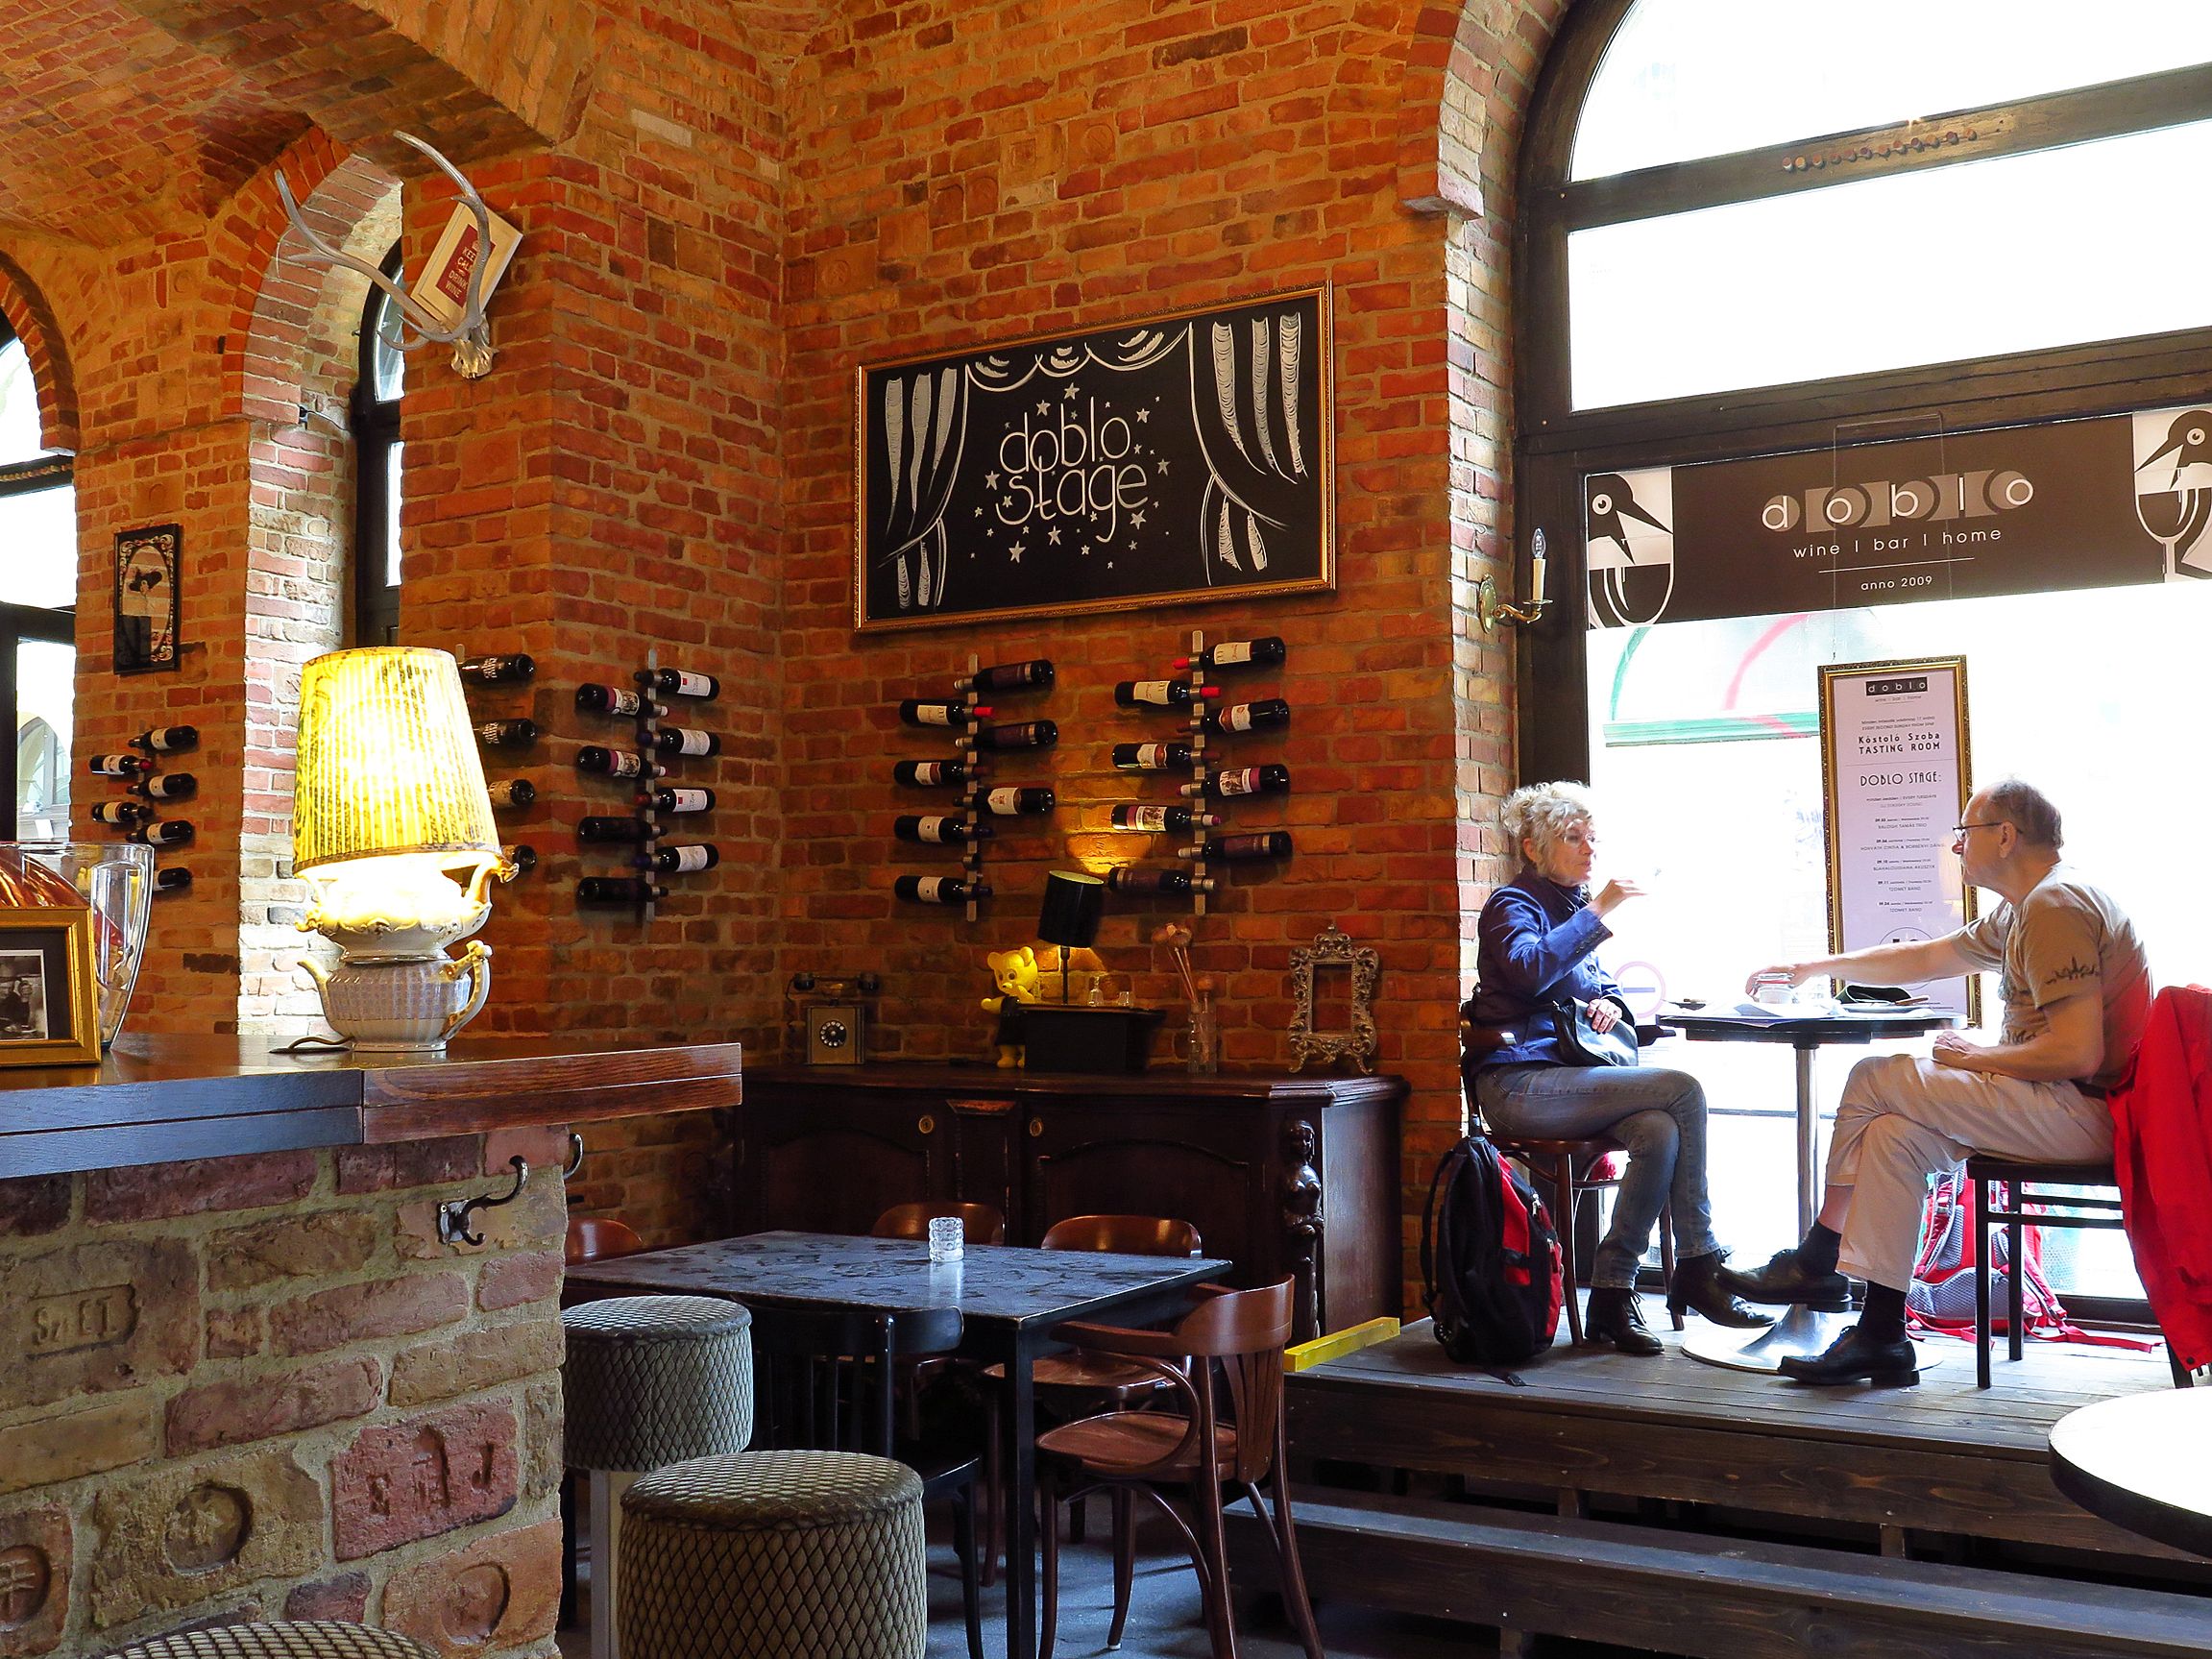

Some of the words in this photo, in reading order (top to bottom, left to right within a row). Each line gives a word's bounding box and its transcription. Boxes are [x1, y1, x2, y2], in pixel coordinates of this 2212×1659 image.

[1000, 396, 1130, 475] doblo
[995, 455, 1148, 543] stage
[1762, 476, 2034, 530] doblo
[1793, 543, 1840, 558] wine
[1874, 536, 1908, 551] bar
[1942, 528, 2003, 546] home
[1860, 580, 1895, 591] anno
[1901, 575, 1933, 588] 2009
[1868, 681, 1926, 693] doblo
[1908, 732, 1940, 742] Szoba
[1859, 744, 1904, 755] TASTING
[1910, 742, 1940, 751] ROOM
[1860, 773, 1904, 787] DOBLO
